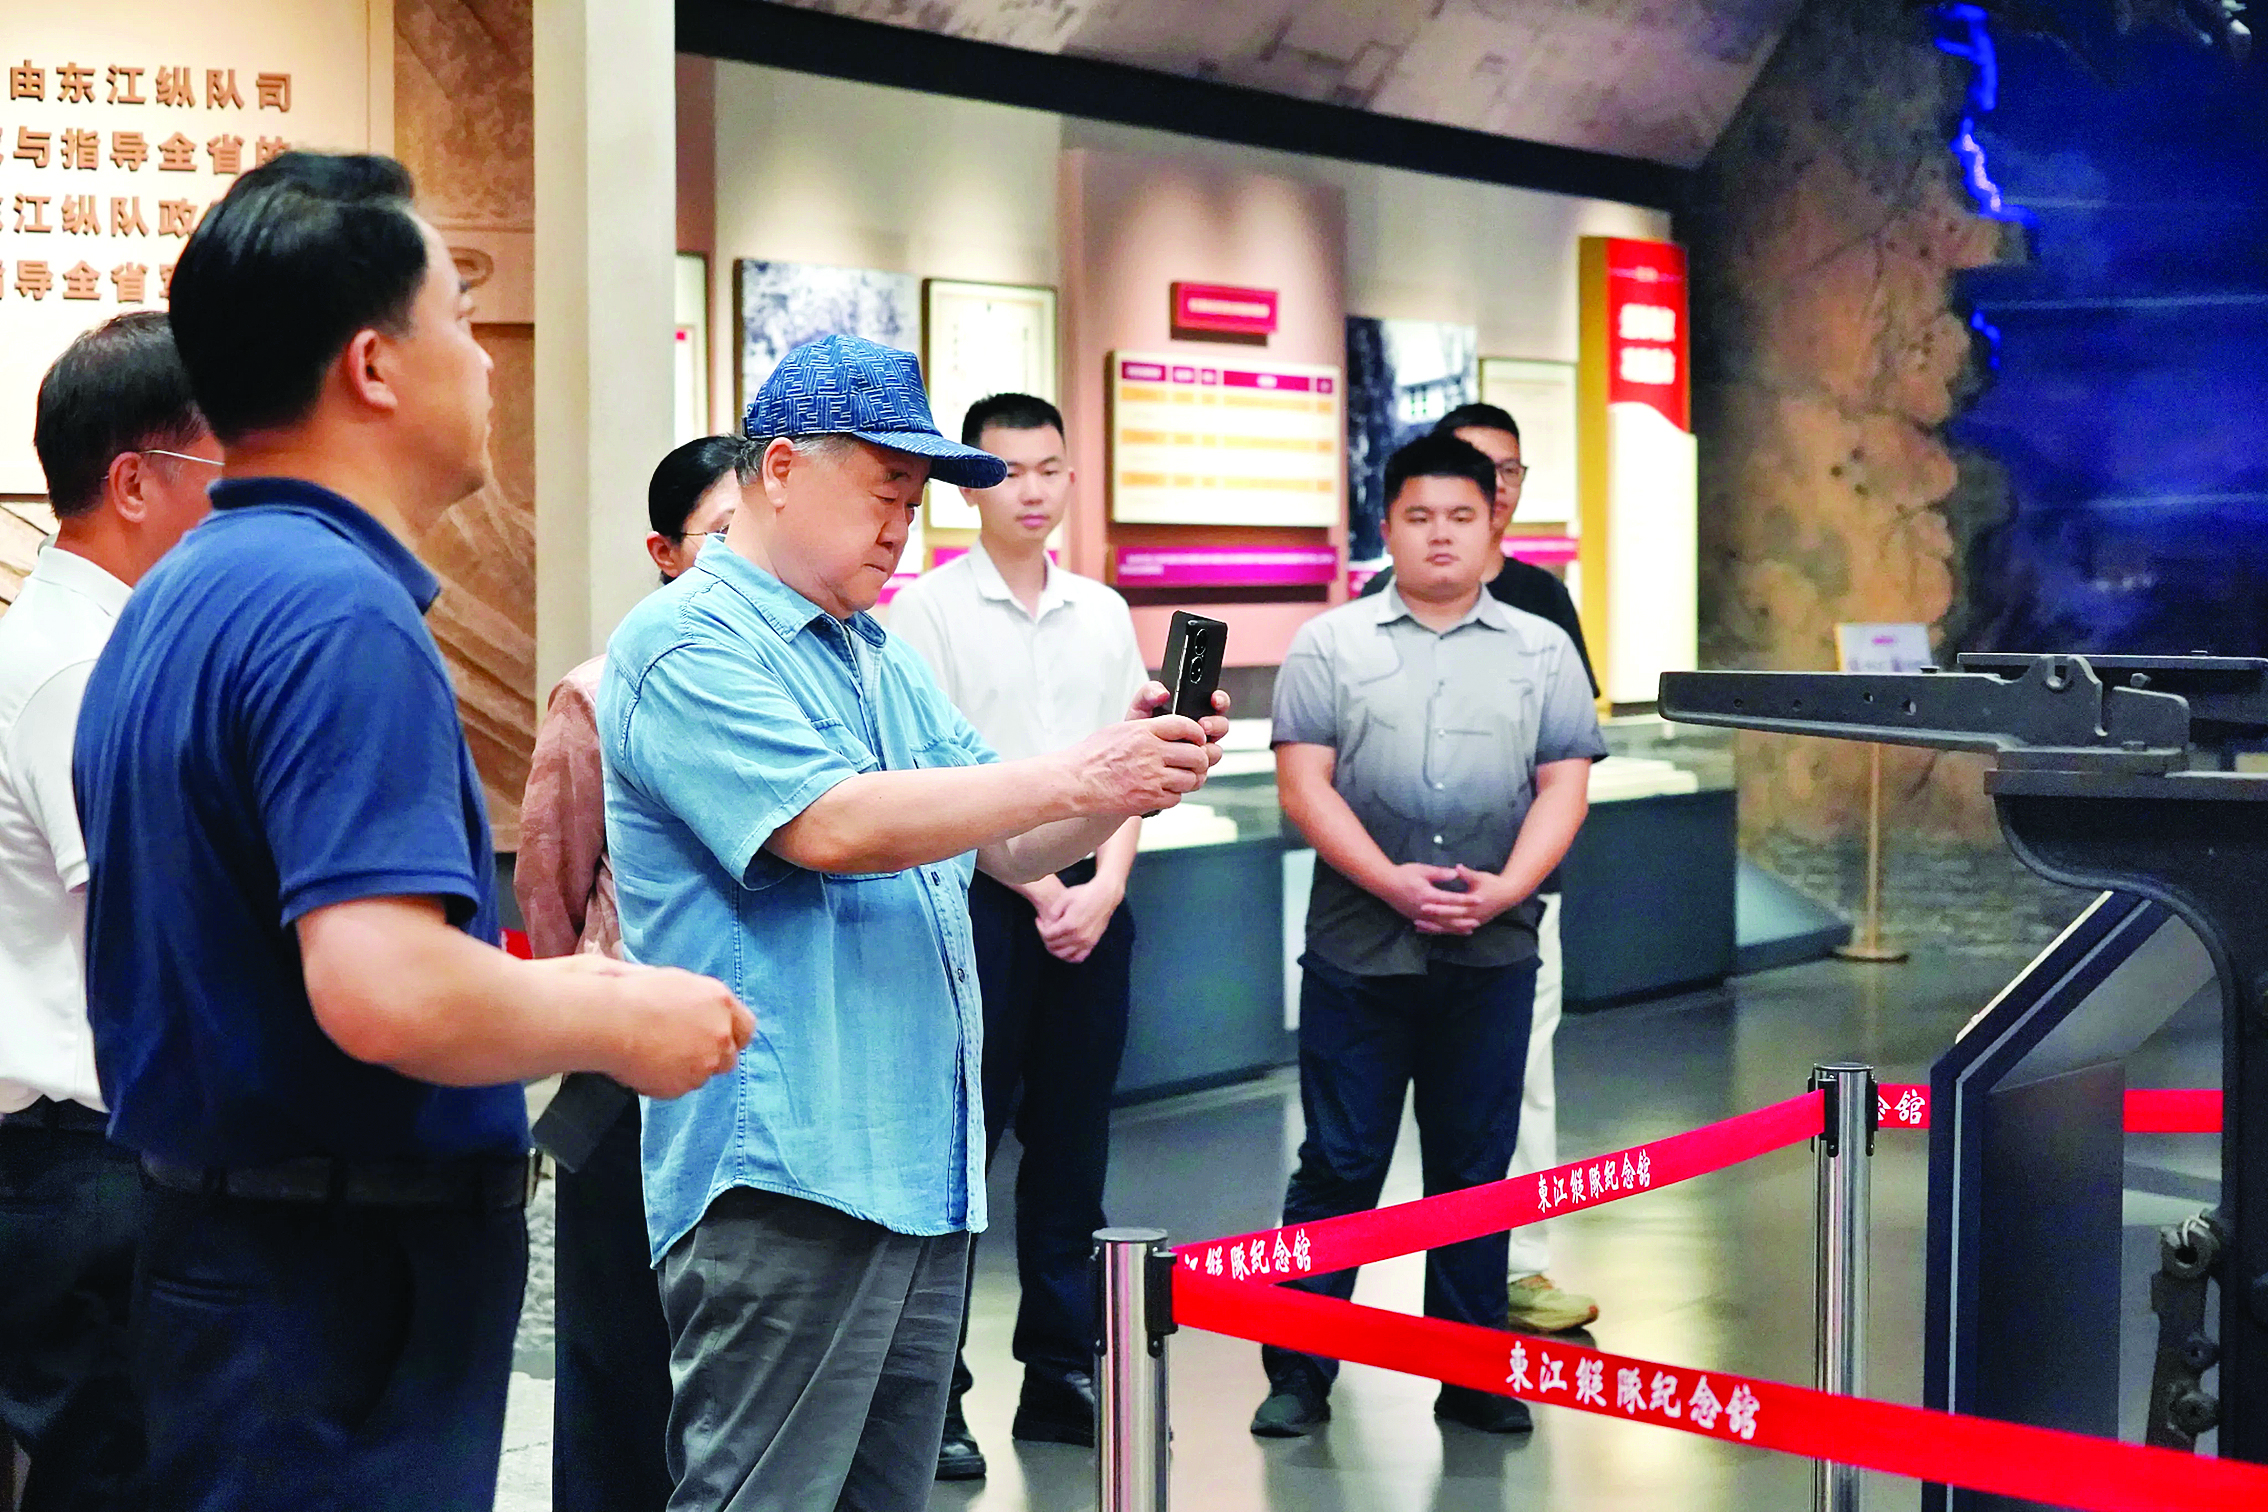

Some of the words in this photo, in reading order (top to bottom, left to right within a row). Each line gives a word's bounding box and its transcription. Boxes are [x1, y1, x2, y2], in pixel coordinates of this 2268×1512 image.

[10, 59, 292, 112] 由东江纵队司
[0, 126, 292, 175] 与指导全省
[0, 193, 223, 238] 江纵队政
[0, 260, 170, 304] 导全省
